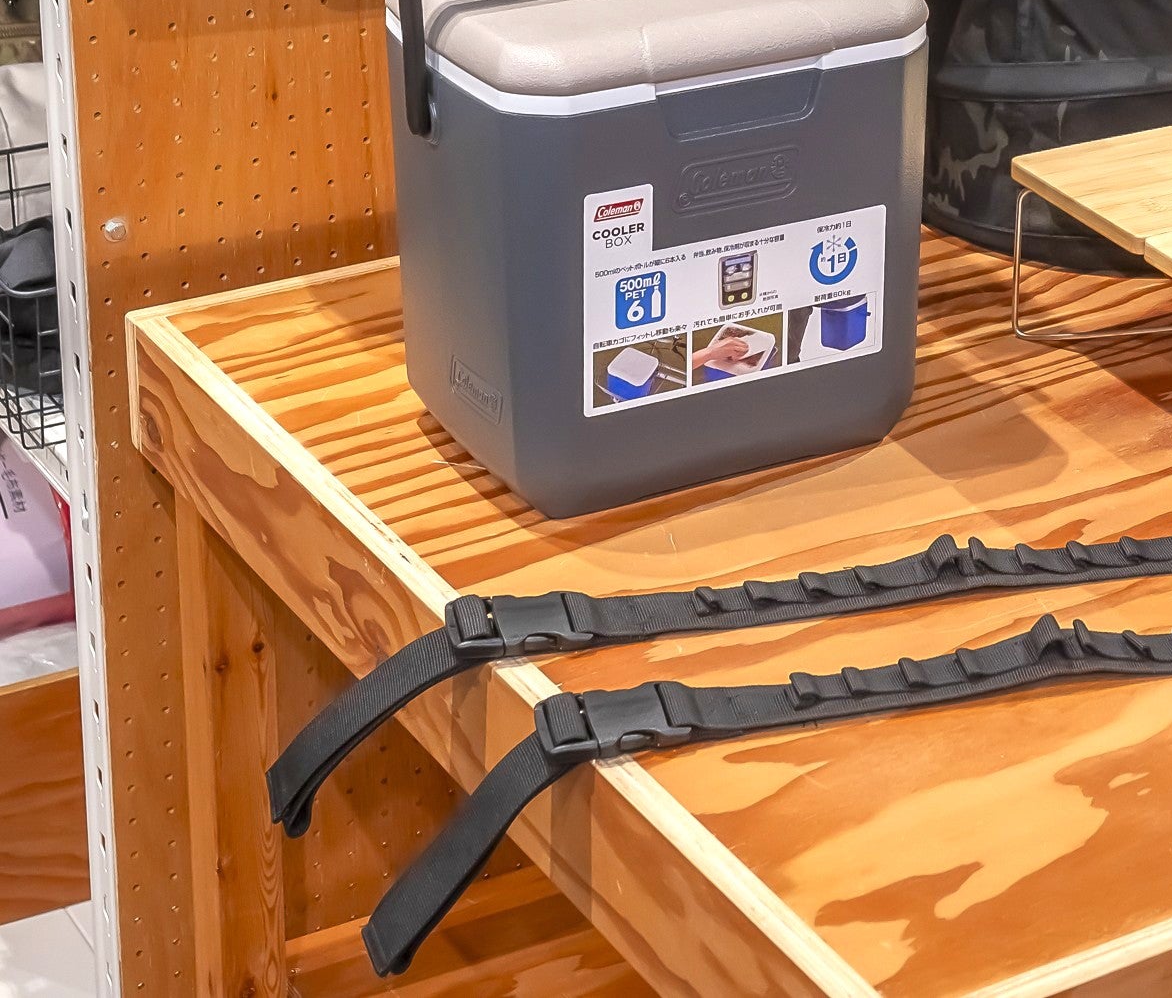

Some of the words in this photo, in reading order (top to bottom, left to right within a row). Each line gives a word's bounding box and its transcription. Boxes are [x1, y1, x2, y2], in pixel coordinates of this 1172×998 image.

[597, 204, 633, 219] Coleman
[592, 222, 645, 241] COOLER
[605, 235, 632, 249] BOX
[625, 288, 647, 301] PET
[626, 299, 645, 322] 6
